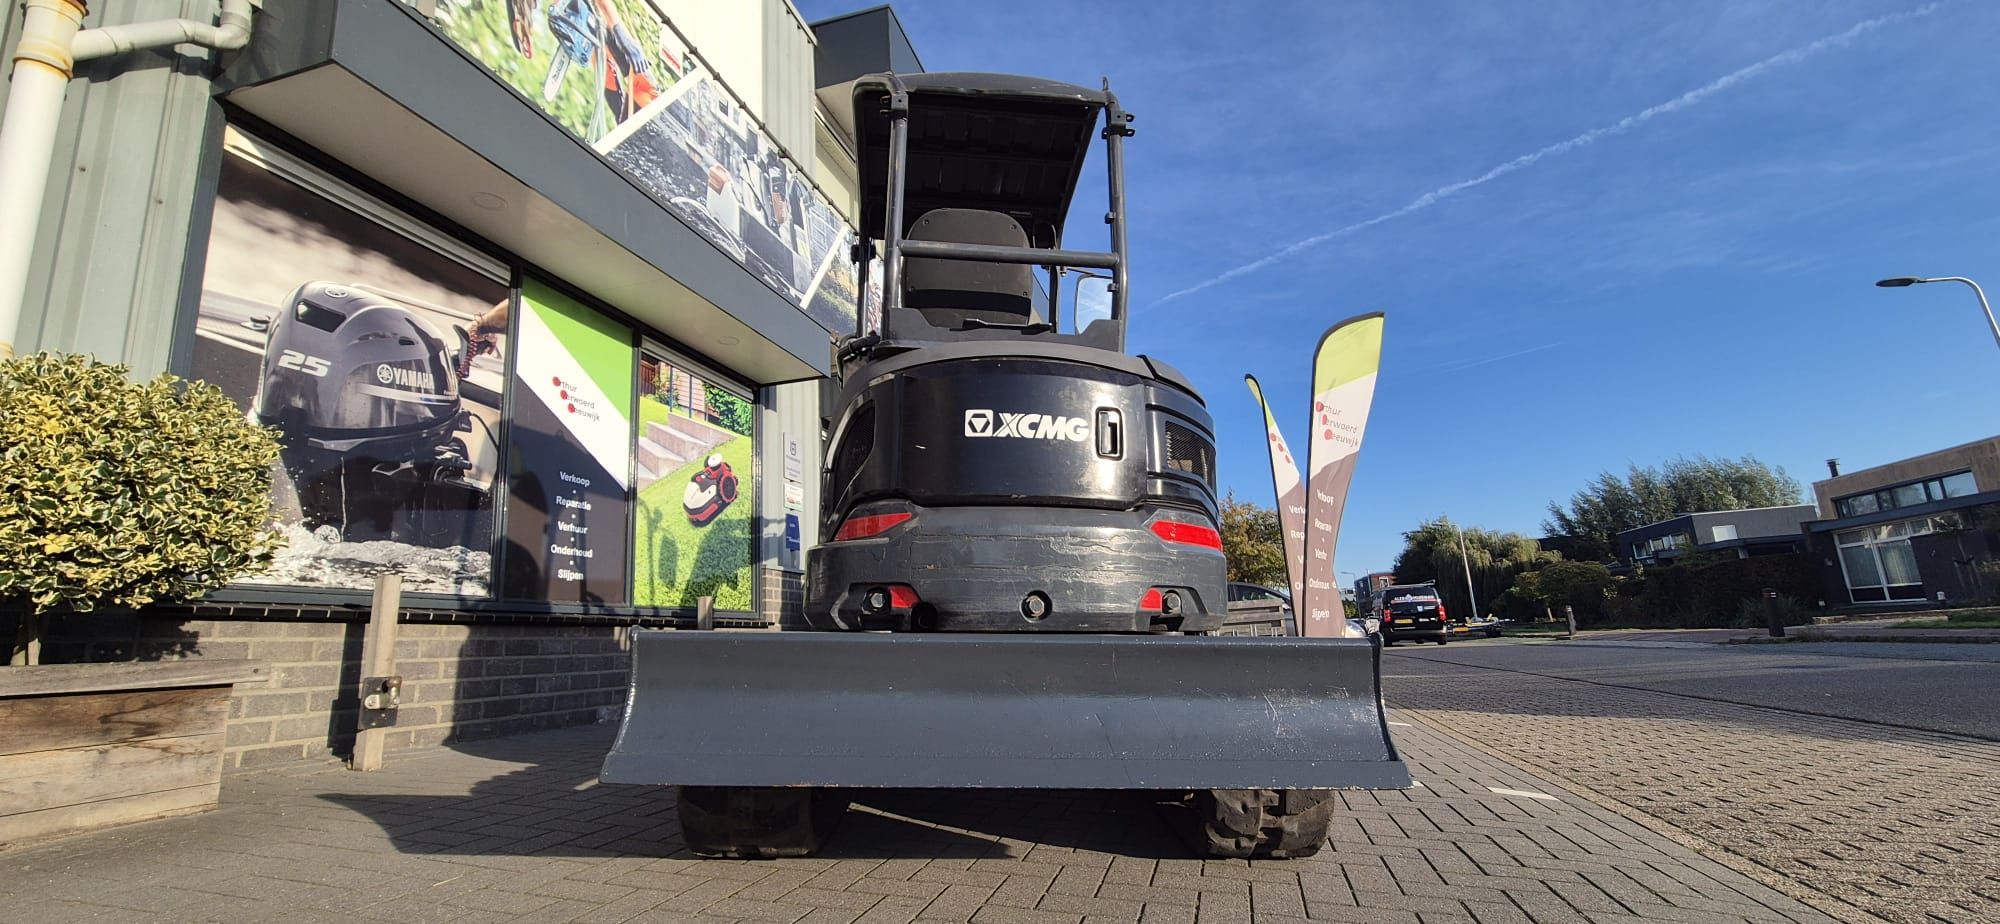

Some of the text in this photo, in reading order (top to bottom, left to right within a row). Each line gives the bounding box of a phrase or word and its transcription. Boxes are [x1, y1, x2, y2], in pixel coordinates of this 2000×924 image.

[278, 349, 332, 378] 25
[393, 367, 435, 389] YAMAHA
[552, 376, 577, 392] rthur
[560, 389, 595, 409] erwoerd
[993, 412, 1090, 442] XCMG
[559, 471, 591, 488] Verkoop
[555, 495, 592, 511] Reparatie
[557, 520, 589, 535] Verhuur
[550, 543, 593, 559] Onderhoud
[557, 568, 584, 582] Slijpen
